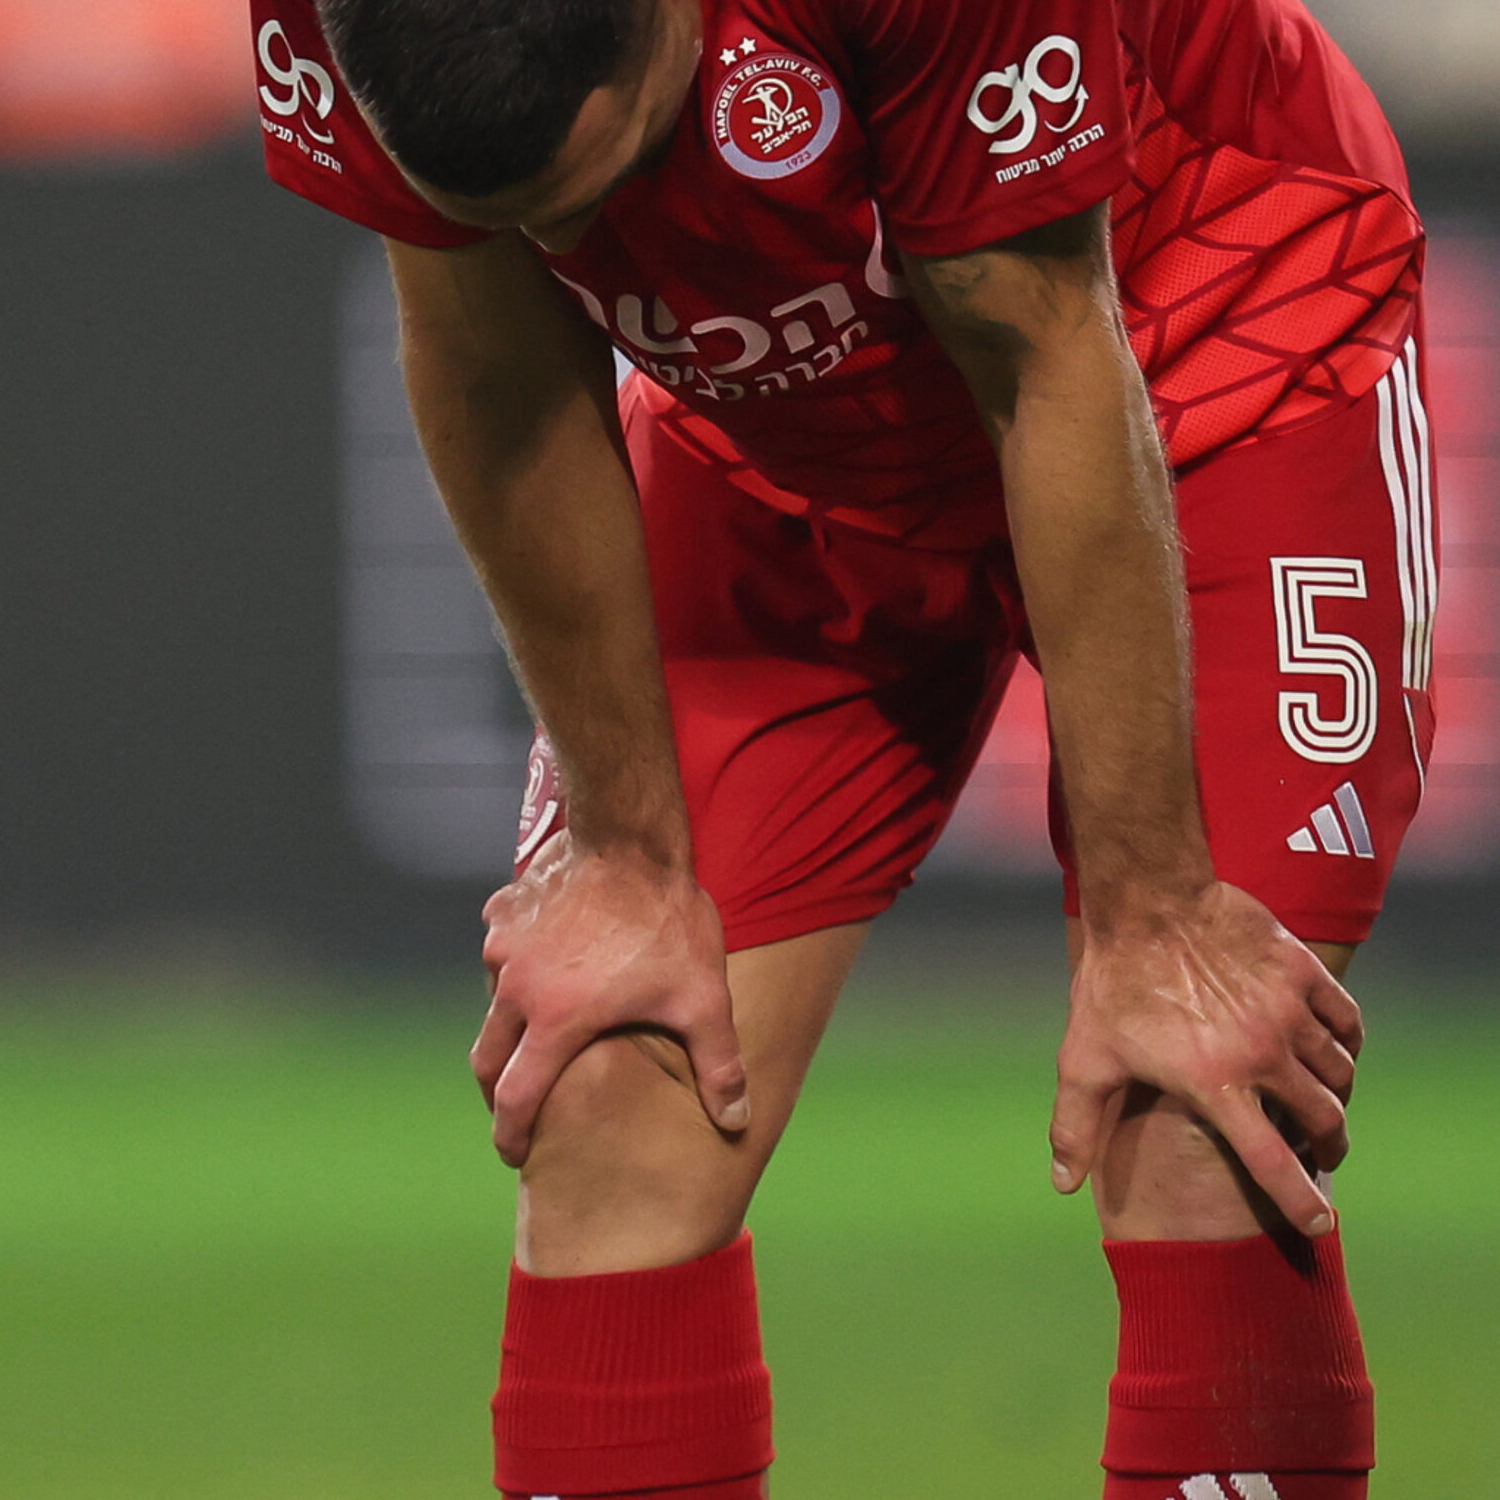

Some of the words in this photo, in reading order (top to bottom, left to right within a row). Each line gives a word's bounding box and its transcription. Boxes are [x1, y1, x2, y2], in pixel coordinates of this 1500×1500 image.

[716, 83, 739, 139] HAPOEL
[735, 58, 800, 82] TEL-AVIV
[801, 66, 823, 86] F.C.
[1067, 123, 1105, 153] הרבה
[785, 151, 812, 170] 1923
[1040, 145, 1067, 168] יותר
[995, 158, 1041, 184] מביטוח
[1269, 557, 1378, 764] 5
